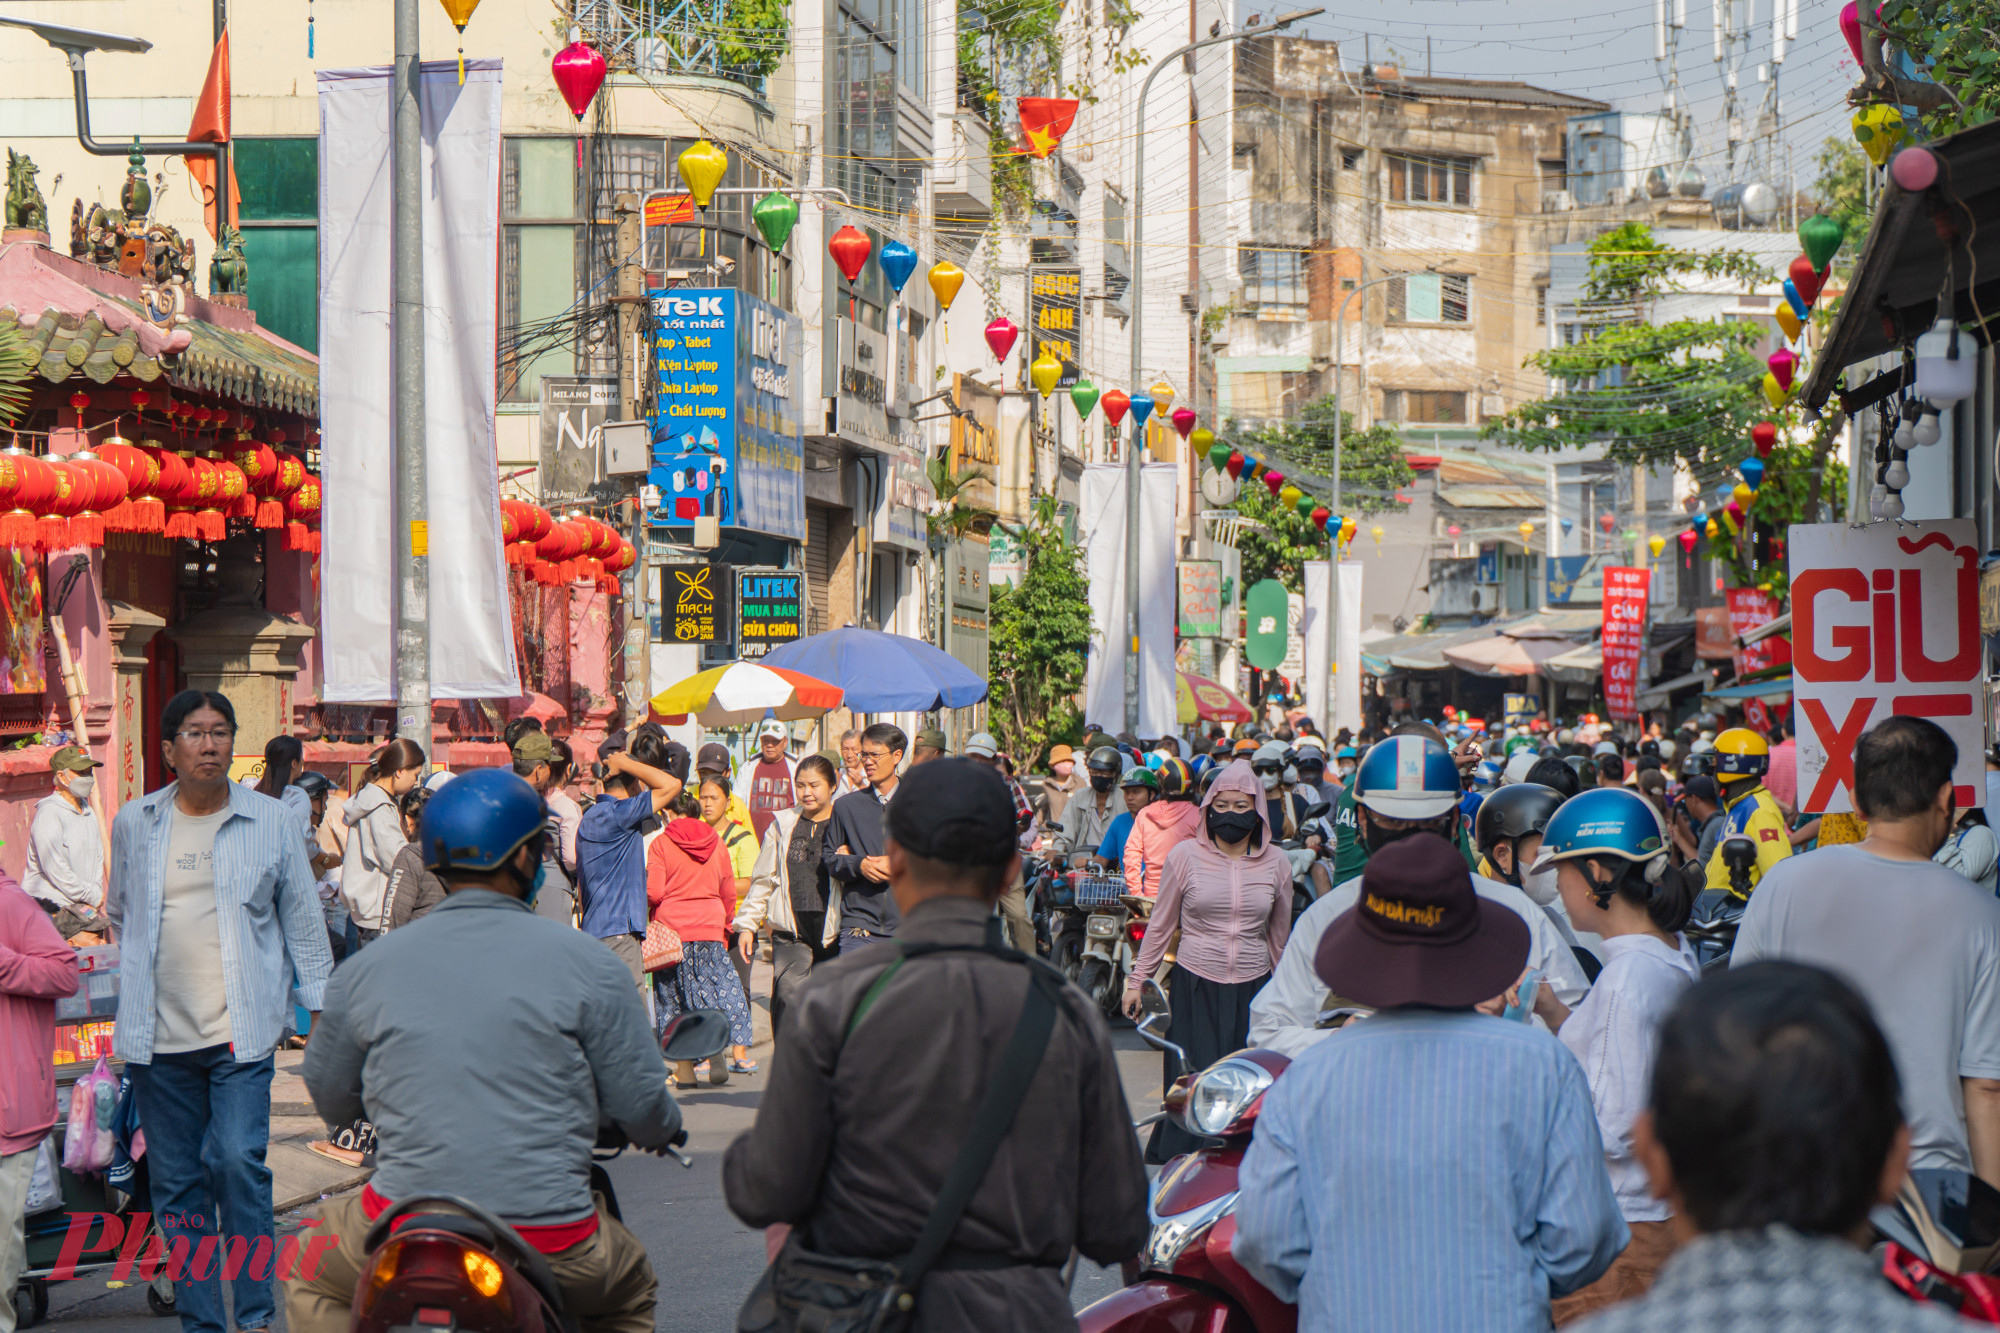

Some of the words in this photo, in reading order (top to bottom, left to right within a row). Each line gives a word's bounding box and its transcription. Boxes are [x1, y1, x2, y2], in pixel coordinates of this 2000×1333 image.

[1034, 274, 1079, 299] NGỌC
[664, 319, 685, 329] tốt
[690, 318, 725, 329] nhất
[1039, 304, 1073, 329] ÁNH
[684, 336, 711, 348] Tabet
[659, 359, 682, 373] Kiện
[685, 359, 718, 373] Laptop
[553, 391, 589, 399] MILANO
[685, 382, 718, 395] Laptop
[670, 404, 693, 417] Chất
[695, 405, 726, 419] Lượng
[743, 578, 798, 598] LITEK
[676, 603, 713, 616] MẠCH
[743, 605, 771, 617] MUA
[773, 602, 798, 617] BÁN
[743, 620, 766, 636] SỬA
[768, 621, 798, 636] CHỮA
[742, 643, 766, 656] LAPTOP
